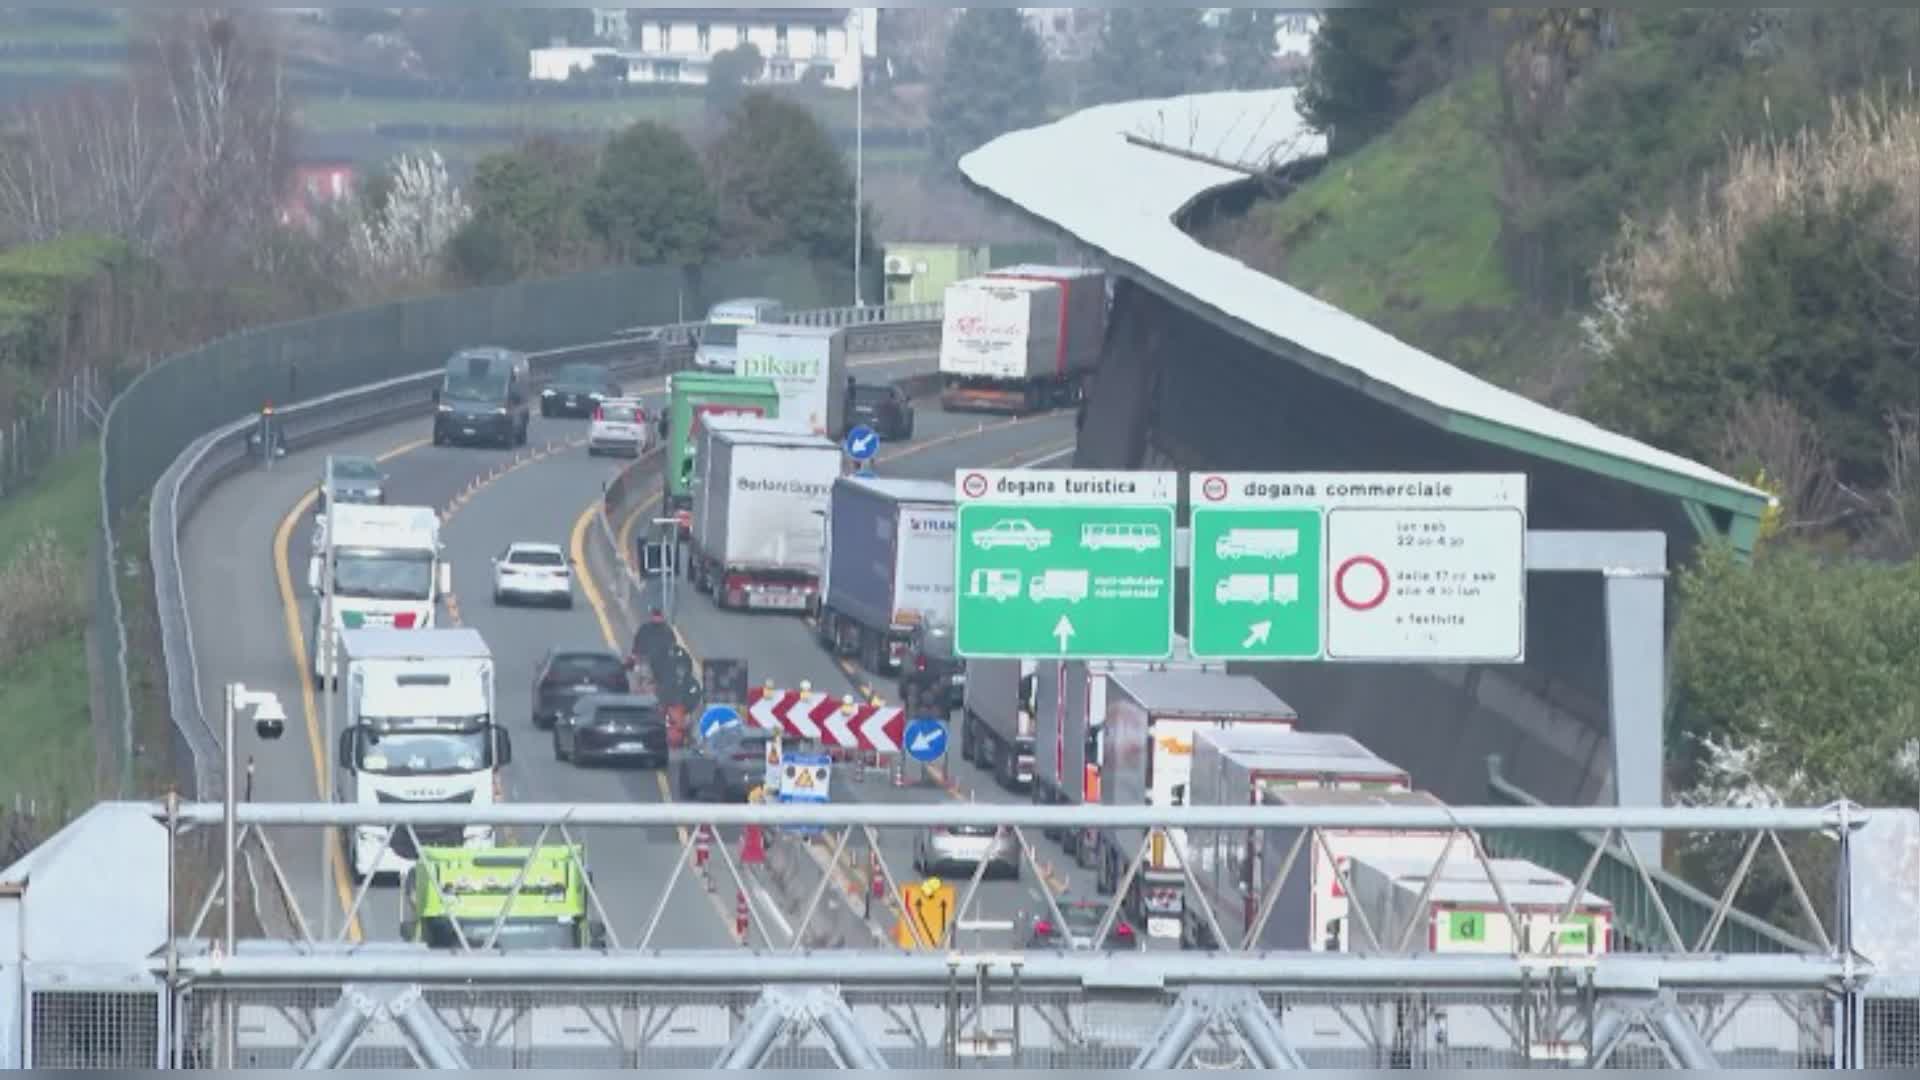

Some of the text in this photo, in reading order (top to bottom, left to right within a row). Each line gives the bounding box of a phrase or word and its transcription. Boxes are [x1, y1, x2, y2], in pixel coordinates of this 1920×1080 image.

[744, 354, 820, 377] pikart
[997, 477, 1055, 496] dogana
[1065, 476, 1136, 494] turistica
[1243, 480, 1453, 498] dogana commerciale
[1460, 919, 1475, 939] d
